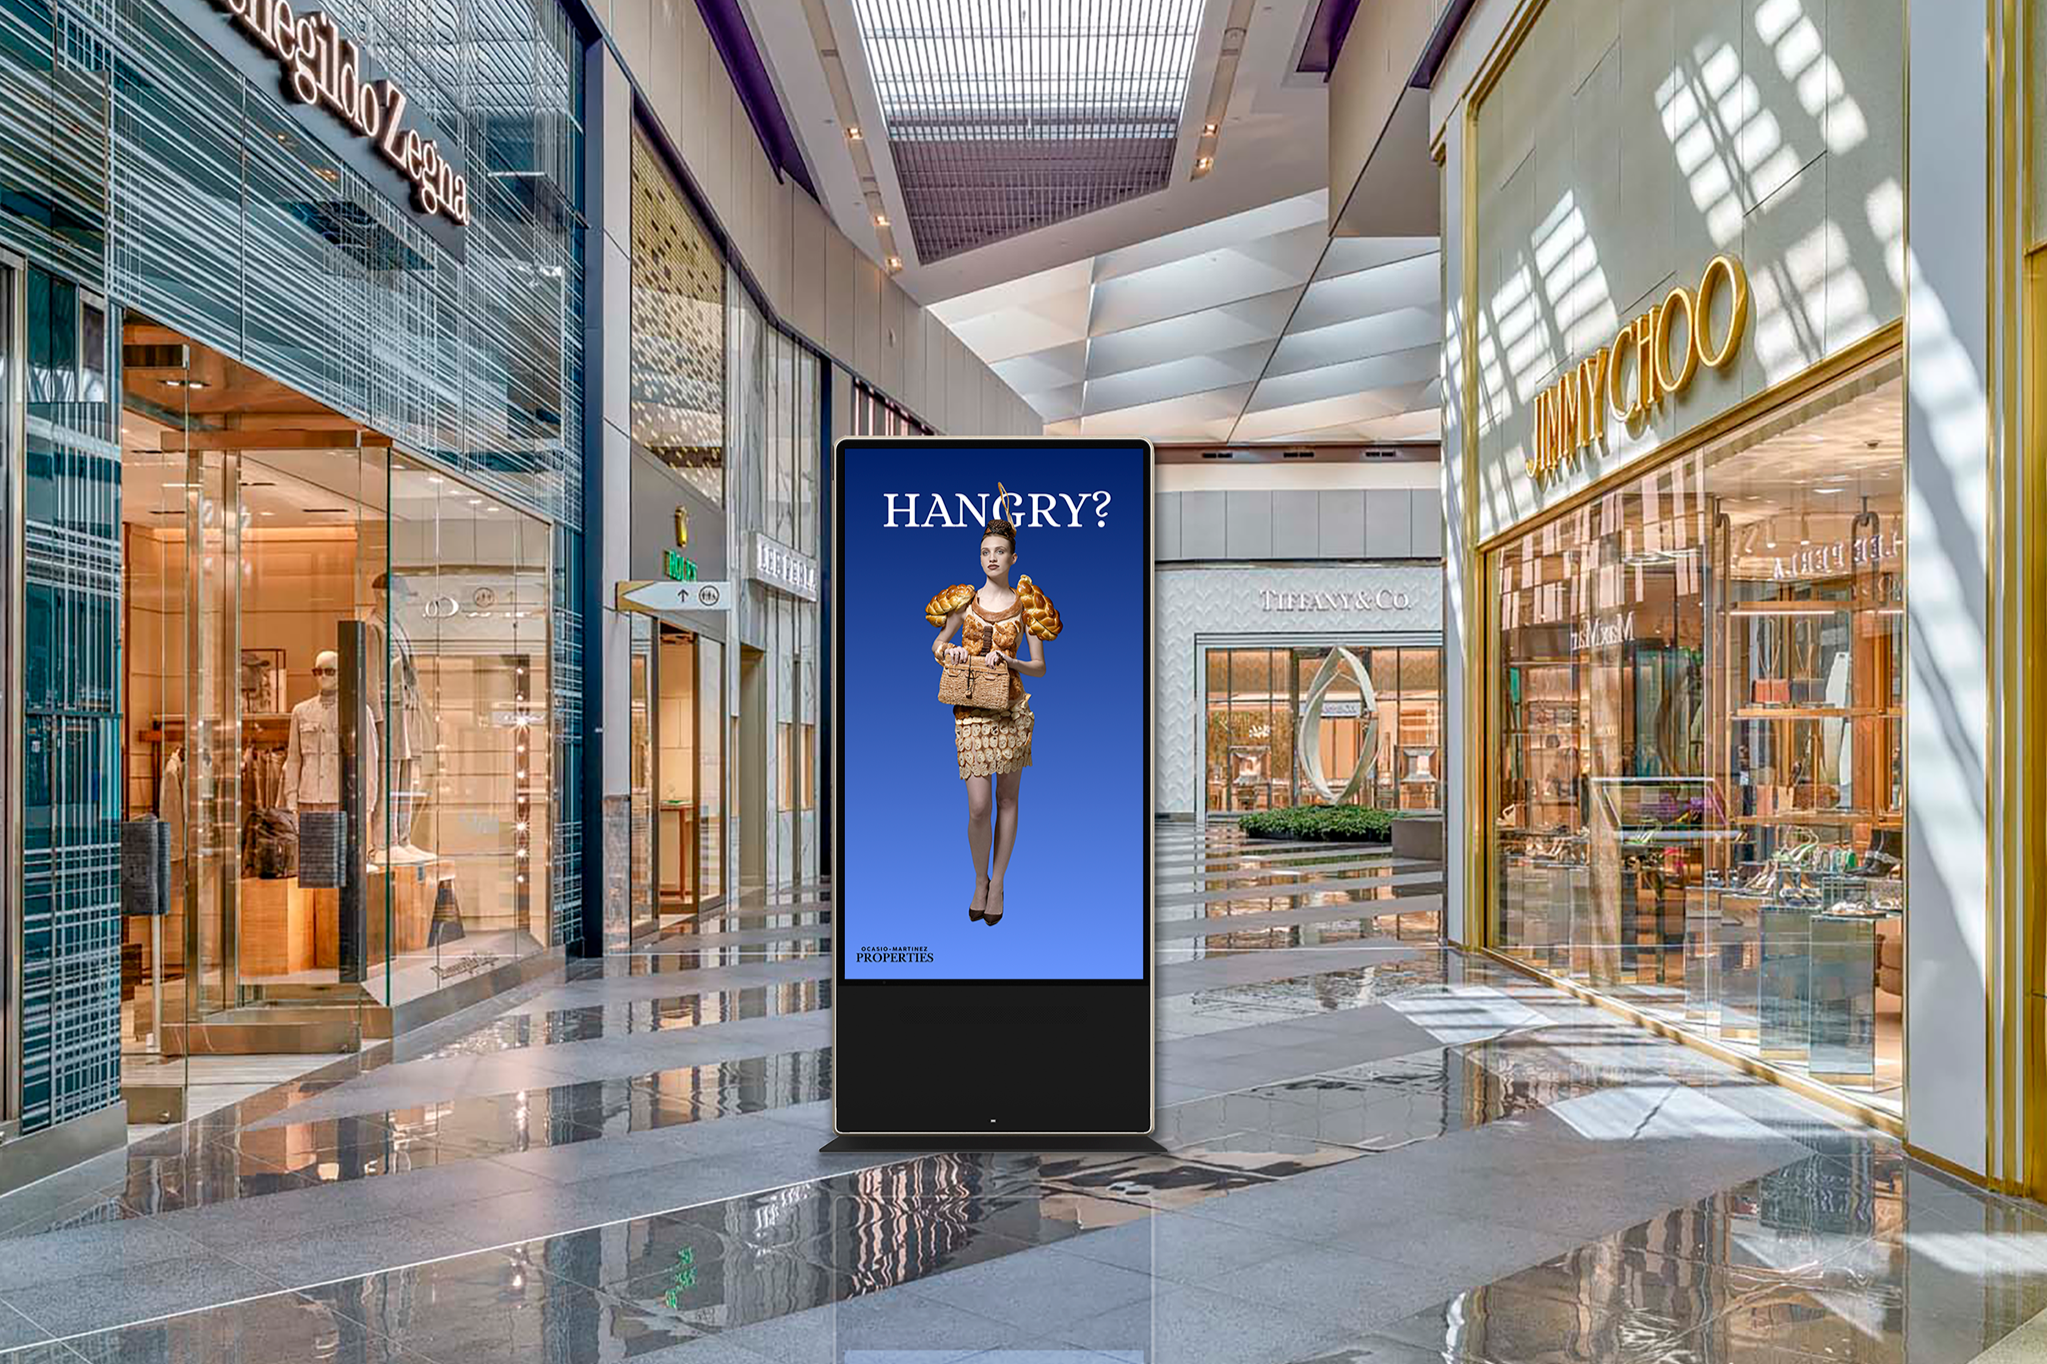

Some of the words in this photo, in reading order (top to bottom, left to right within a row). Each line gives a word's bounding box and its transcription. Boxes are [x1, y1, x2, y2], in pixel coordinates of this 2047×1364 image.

[384, 80, 469, 226] Zegna
[1525, 347, 1609, 478] JIMMY
[1609, 254, 1749, 422] CHOO
[883, 490, 1112, 528] HANGRY?
[1260, 590, 1353, 612] TIFFANY
[1355, 591, 1372, 611] &
[856, 952, 935, 963] PROPERTIES
